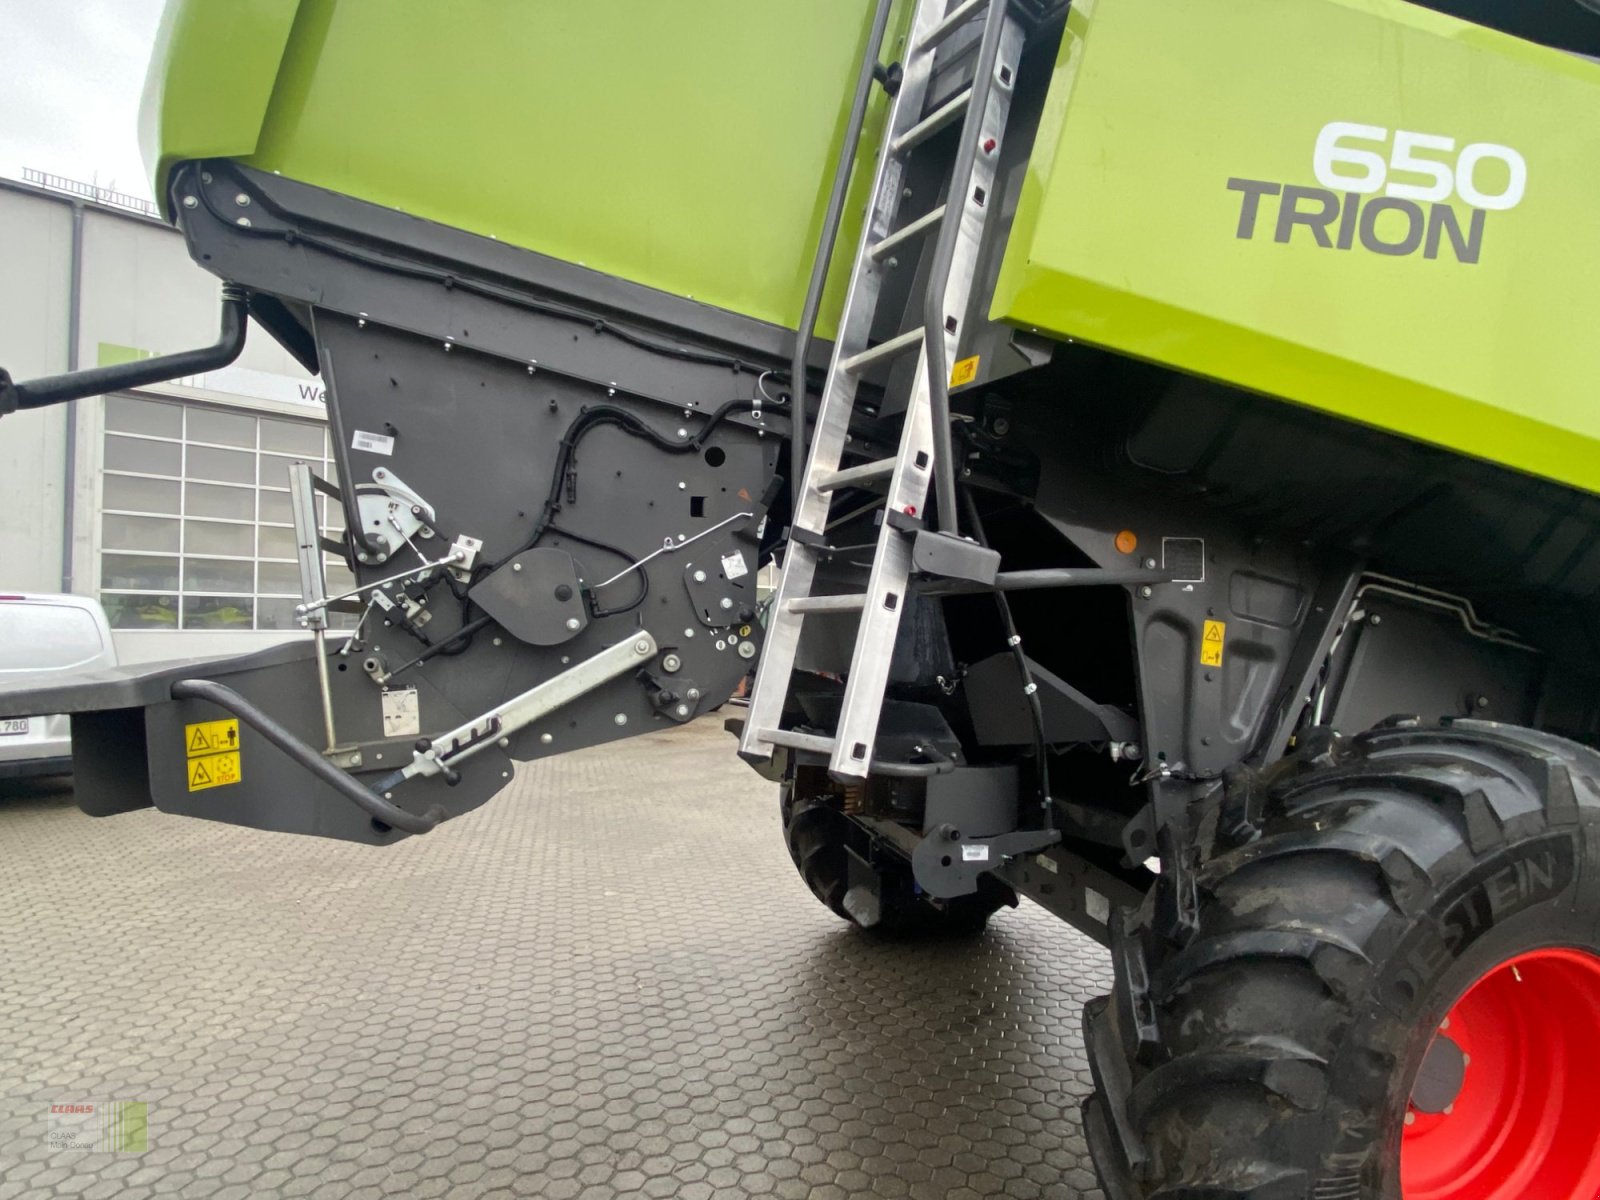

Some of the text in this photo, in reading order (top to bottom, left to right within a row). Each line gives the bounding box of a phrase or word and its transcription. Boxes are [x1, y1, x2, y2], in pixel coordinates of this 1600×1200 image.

[1313, 121, 1527, 210] 650
[1226, 177, 1487, 264] TRION
[4, 720, 27, 731] 780
[216, 773, 236, 784] STOP
